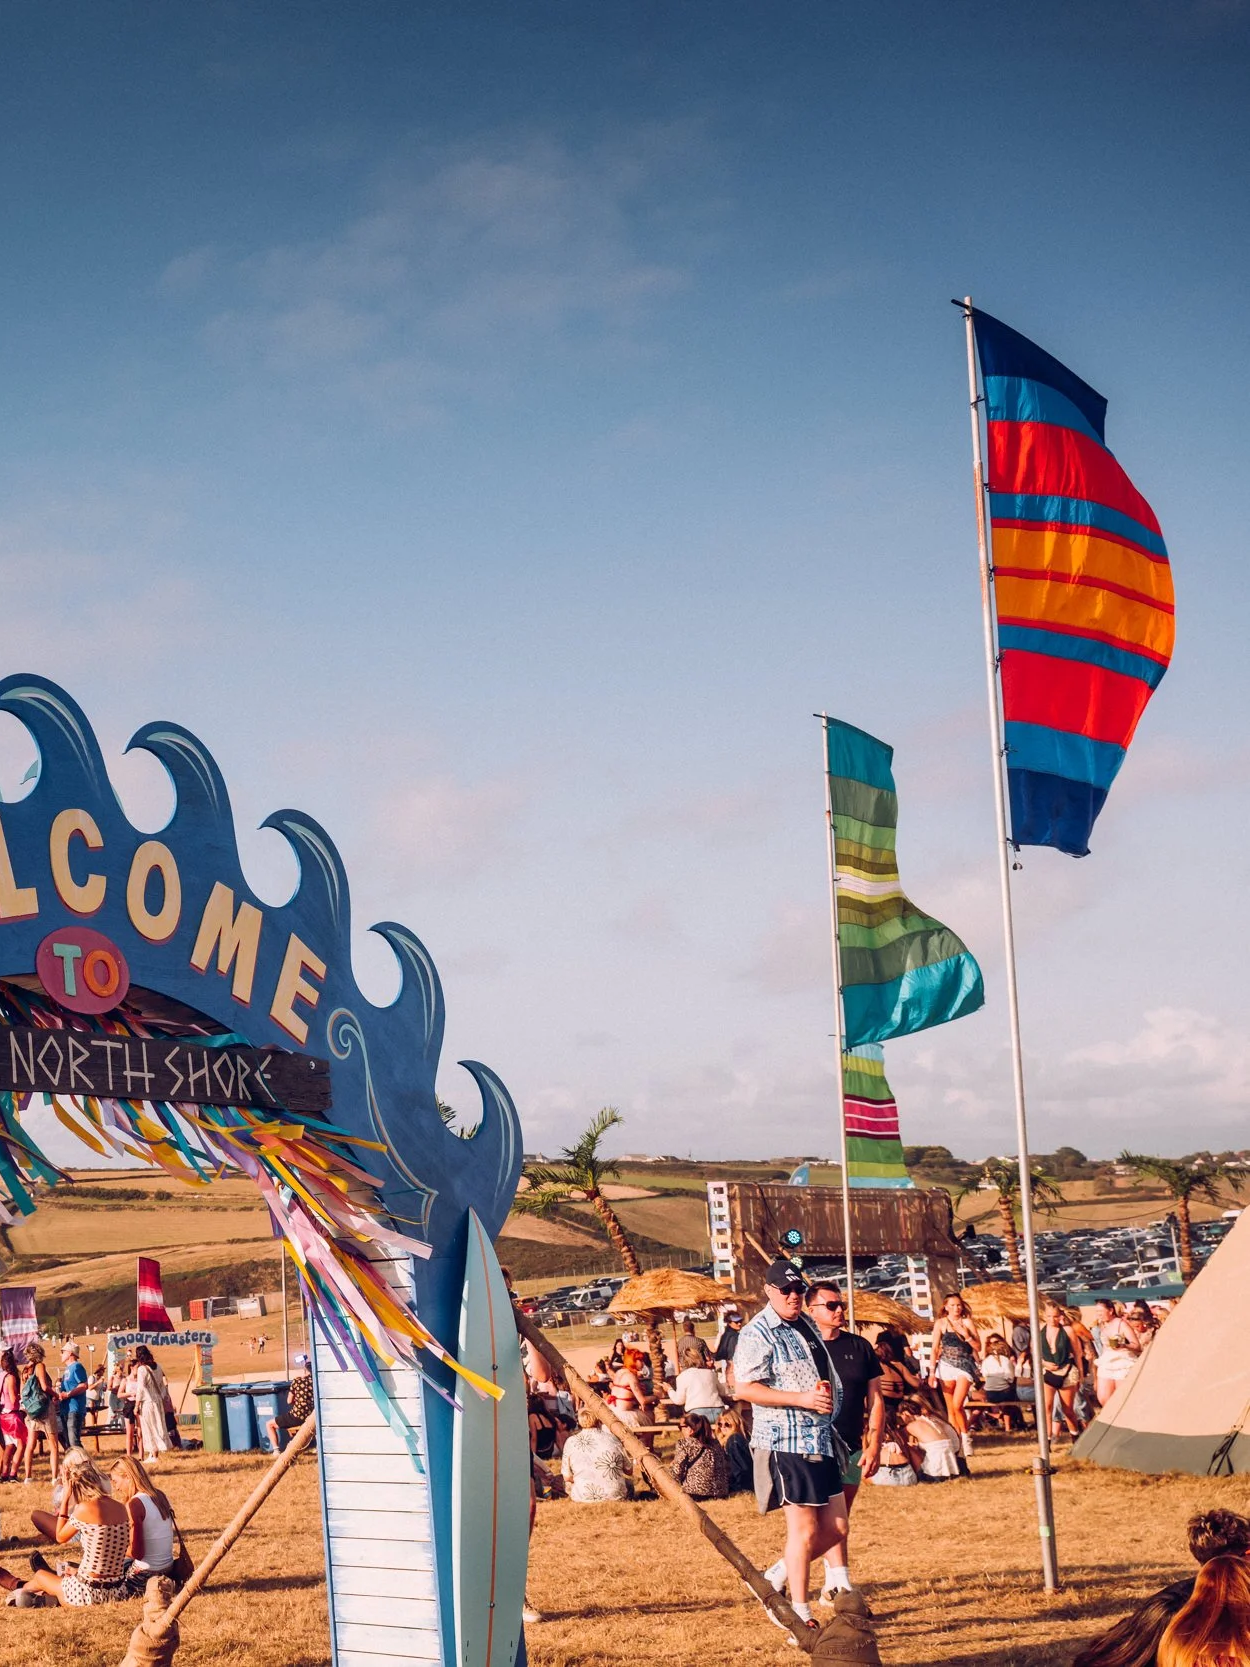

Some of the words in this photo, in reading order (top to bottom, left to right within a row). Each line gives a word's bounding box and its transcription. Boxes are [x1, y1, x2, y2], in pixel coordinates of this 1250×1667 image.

[52, 942, 120, 998] TO
[9, 1030, 156, 1095] NORTH
[163, 1045, 277, 1103] SHORE
